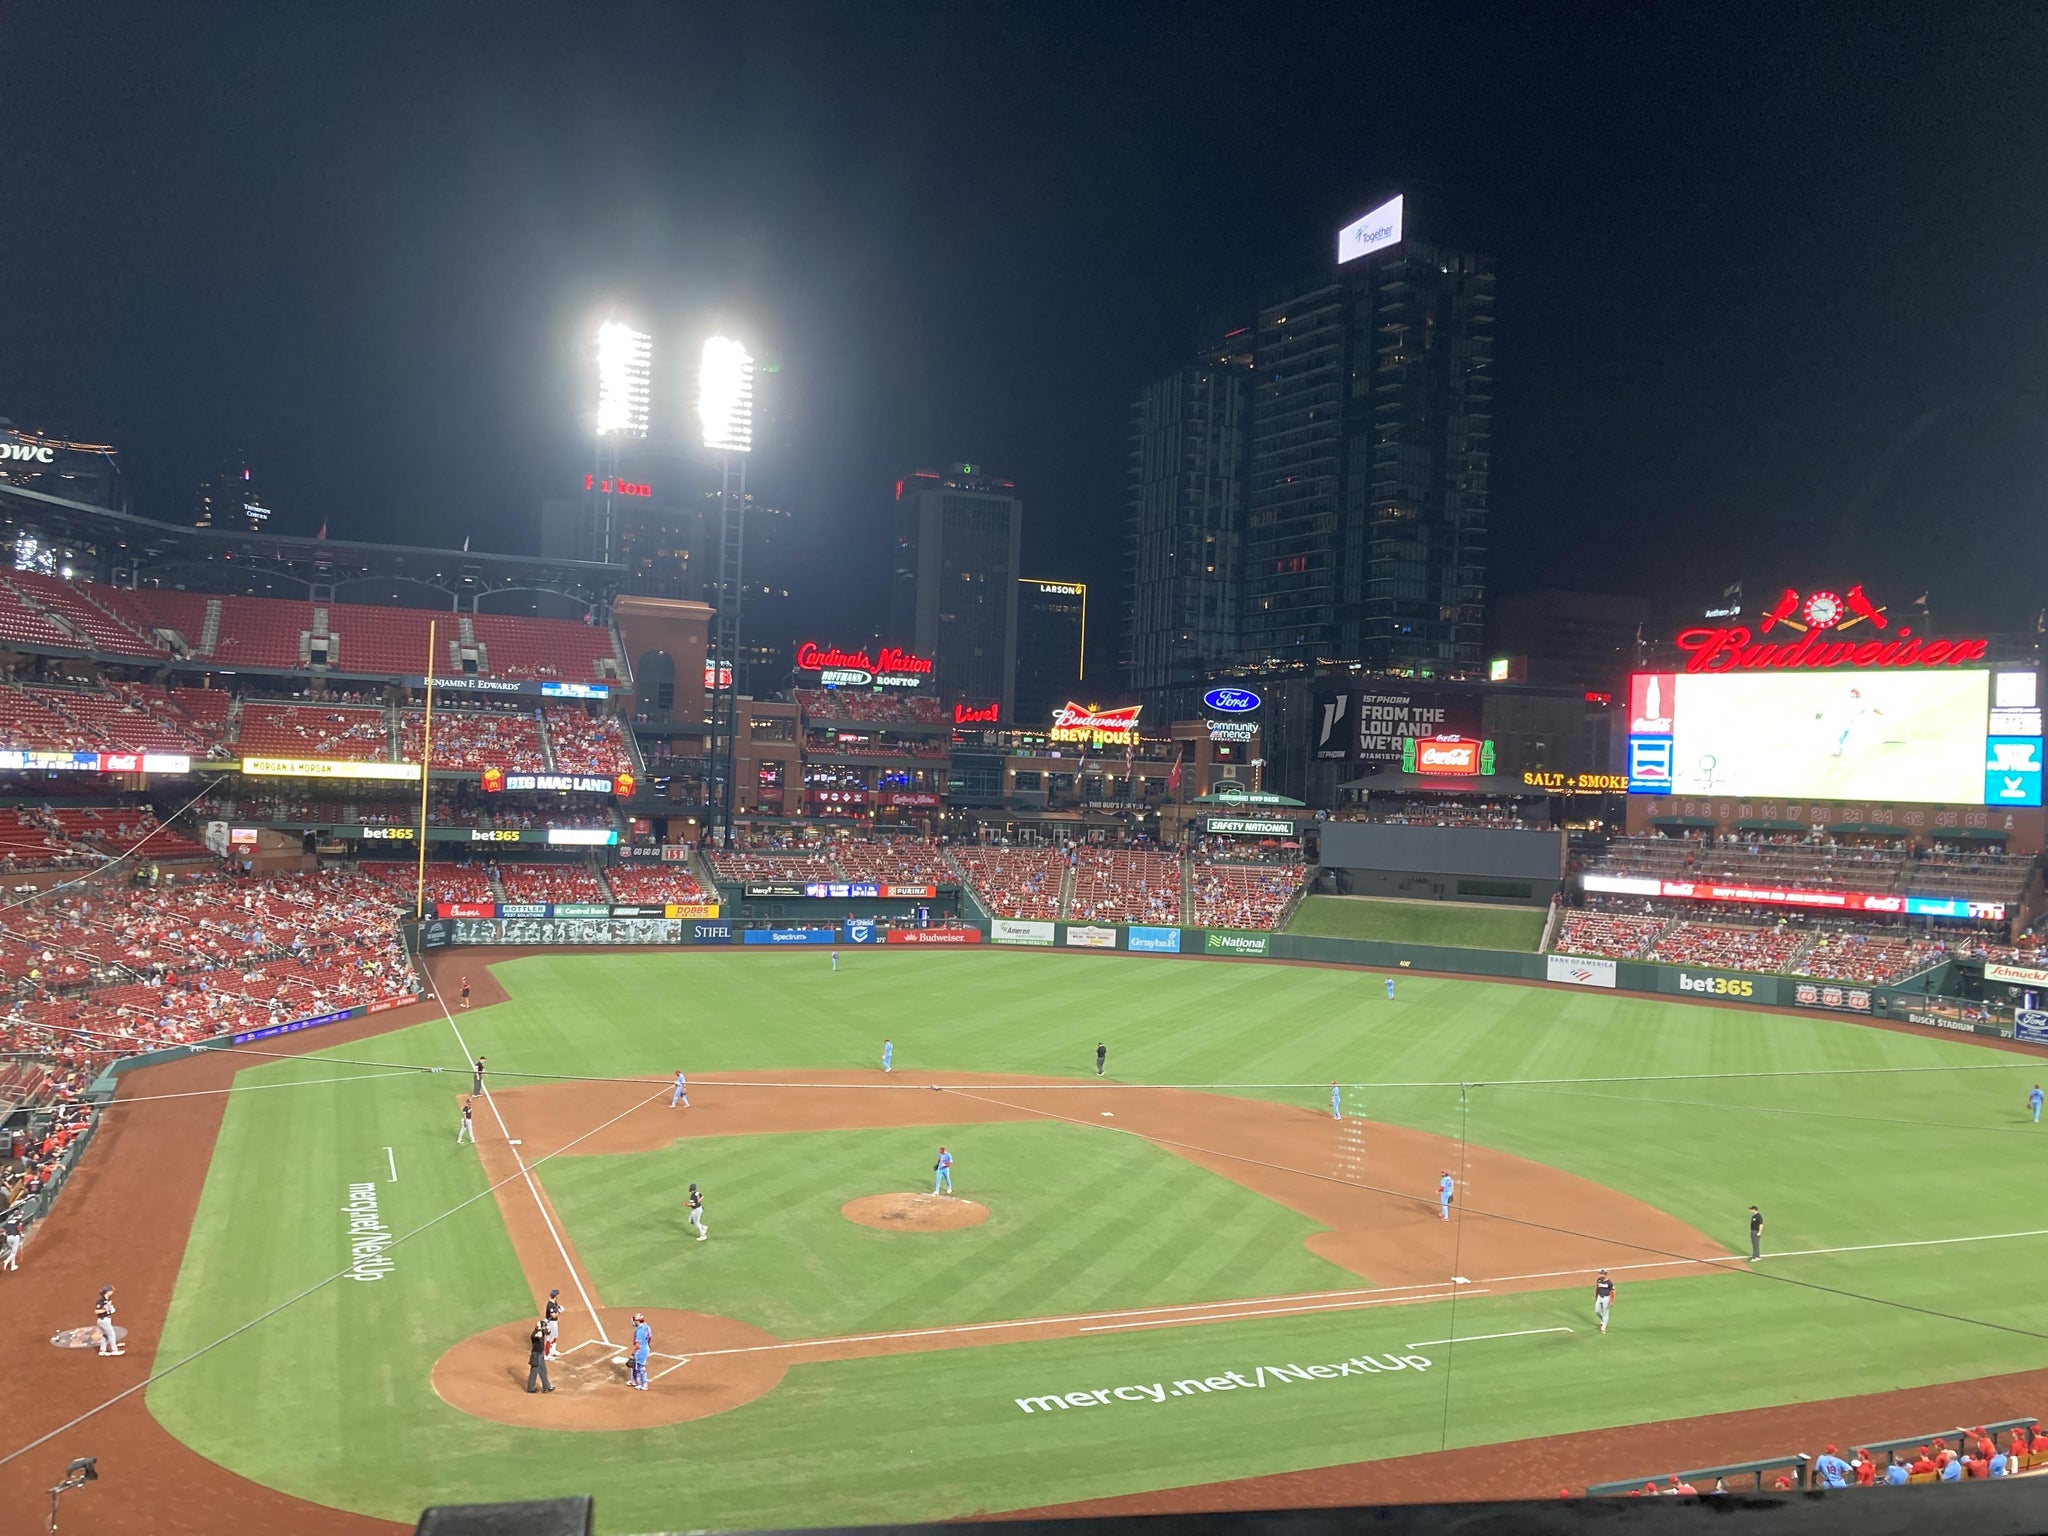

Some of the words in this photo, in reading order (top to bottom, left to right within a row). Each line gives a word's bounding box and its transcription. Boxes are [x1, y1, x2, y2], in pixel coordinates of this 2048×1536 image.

[1040, 584, 1075, 595] LARSON
[1675, 626, 1988, 673] Budweiser
[797, 641, 871, 670] Cardinals
[869, 647, 932, 675] Nation
[424, 677, 467, 688] BENJAMIN
[468, 680, 476, 688] F.
[478, 680, 519, 691] EDWARDS
[821, 671, 864, 683] HOFFMANN
[876, 676, 920, 687] ROOFTOP
[1216, 690, 1250, 708] Ford
[1363, 695, 1376, 703] 1ST
[1376, 696, 1410, 704] PHORM
[954, 703, 999, 724] Live!
[1052, 709, 1139, 729] Budweiser
[1361, 706, 1409, 721] FROM
[1412, 708, 1445, 723] THE
[1206, 720, 1259, 734] Community
[1360, 721, 1393, 735] LOU
[1396, 723, 1432, 737] AND
[1051, 727, 1091, 743] BREW
[1360, 735, 1404, 750] WE'R
[1422, 748, 1472, 766] Coca-Cola
[253, 763, 287, 772] MORGAN
[290, 764, 295, 772] &
[298, 764, 332, 773] MORGAN
[506, 777, 536, 789] BIG
[537, 777, 572, 790] MAC
[573, 778, 612, 792] LAND
[1523, 772, 1564, 786] SALT
[1578, 775, 1629, 789] SMOKE
[1672, 802, 1677, 814] 1
[1684, 803, 1695, 816] 2
[1702, 803, 1712, 817] 6
[1720, 803, 1730, 817] 9
[1739, 804, 1753, 818] 10
[1762, 805, 1777, 820] 14
[1786, 807, 1802, 821] 17
[1811, 808, 1831, 822] 20
[1843, 809, 1863, 823] 23
[1872, 810, 1893, 824] 24
[1903, 811, 1925, 826] 42
[1935, 812, 1957, 827] 45
[1965, 813, 1987, 828] 85
[363, 827, 414, 839] bet365
[1211, 822, 1244, 831] SAFETY
[1245, 823, 1289, 833] NATIONAL
[471, 829, 520, 841] bet365
[633, 847, 642, 856] GO
[642, 848, 651, 856] GO
[651, 848, 660, 856] GO
[752, 887, 769, 895] Mercy
[565, 905, 589, 915] Central
[590, 906, 609, 915] Bank
[694, 926, 731, 938] STIFEL
[772, 933, 804, 941] Spectrum
[920, 933, 965, 942] Budweiser
[1006, 927, 1031, 935] Ameren
[1221, 937, 1265, 948] National
[1581, 960, 1614, 968] AMERICA
[1679, 974, 1753, 997] bet365
[1801, 992, 1813, 1000] 66
[1852, 998, 1865, 1006] 66
[1909, 1014, 1935, 1026] BUSCH
[1937, 1019, 1974, 1033] STADIUM
[2022, 1013, 2046, 1027] Ford
[341, 1182, 396, 1281] mercy.net/NextUp
[1014, 1353, 1432, 1413] mercy.net/NextUp
